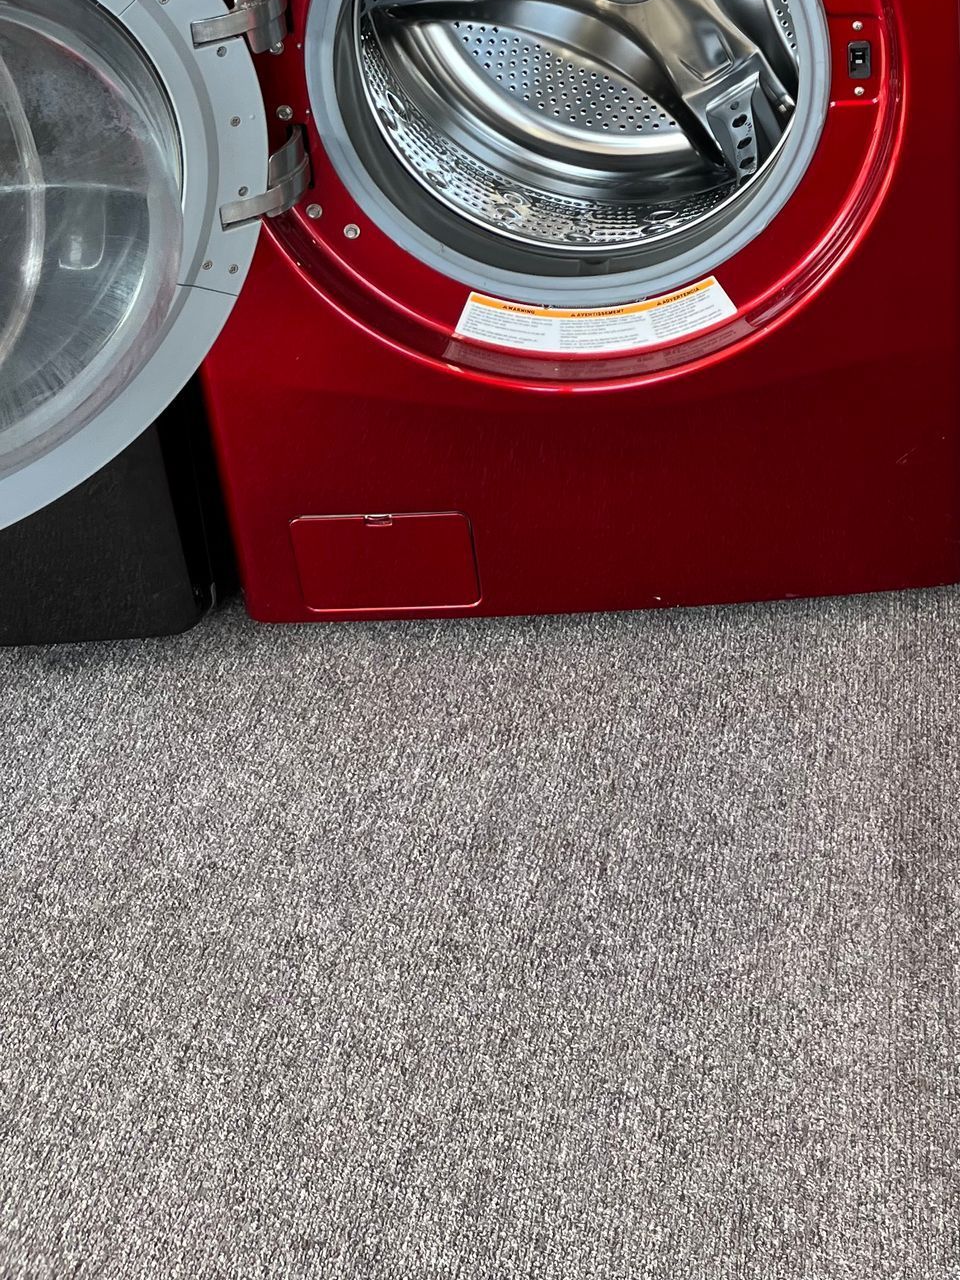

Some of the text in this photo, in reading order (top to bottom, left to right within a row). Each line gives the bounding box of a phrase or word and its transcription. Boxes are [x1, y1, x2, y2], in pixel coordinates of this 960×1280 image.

[662, 287, 700, 304] ADVERTENCIA
[508, 306, 536, 315] WARNING
[577, 309, 625, 317] AVERTISSEMENT
